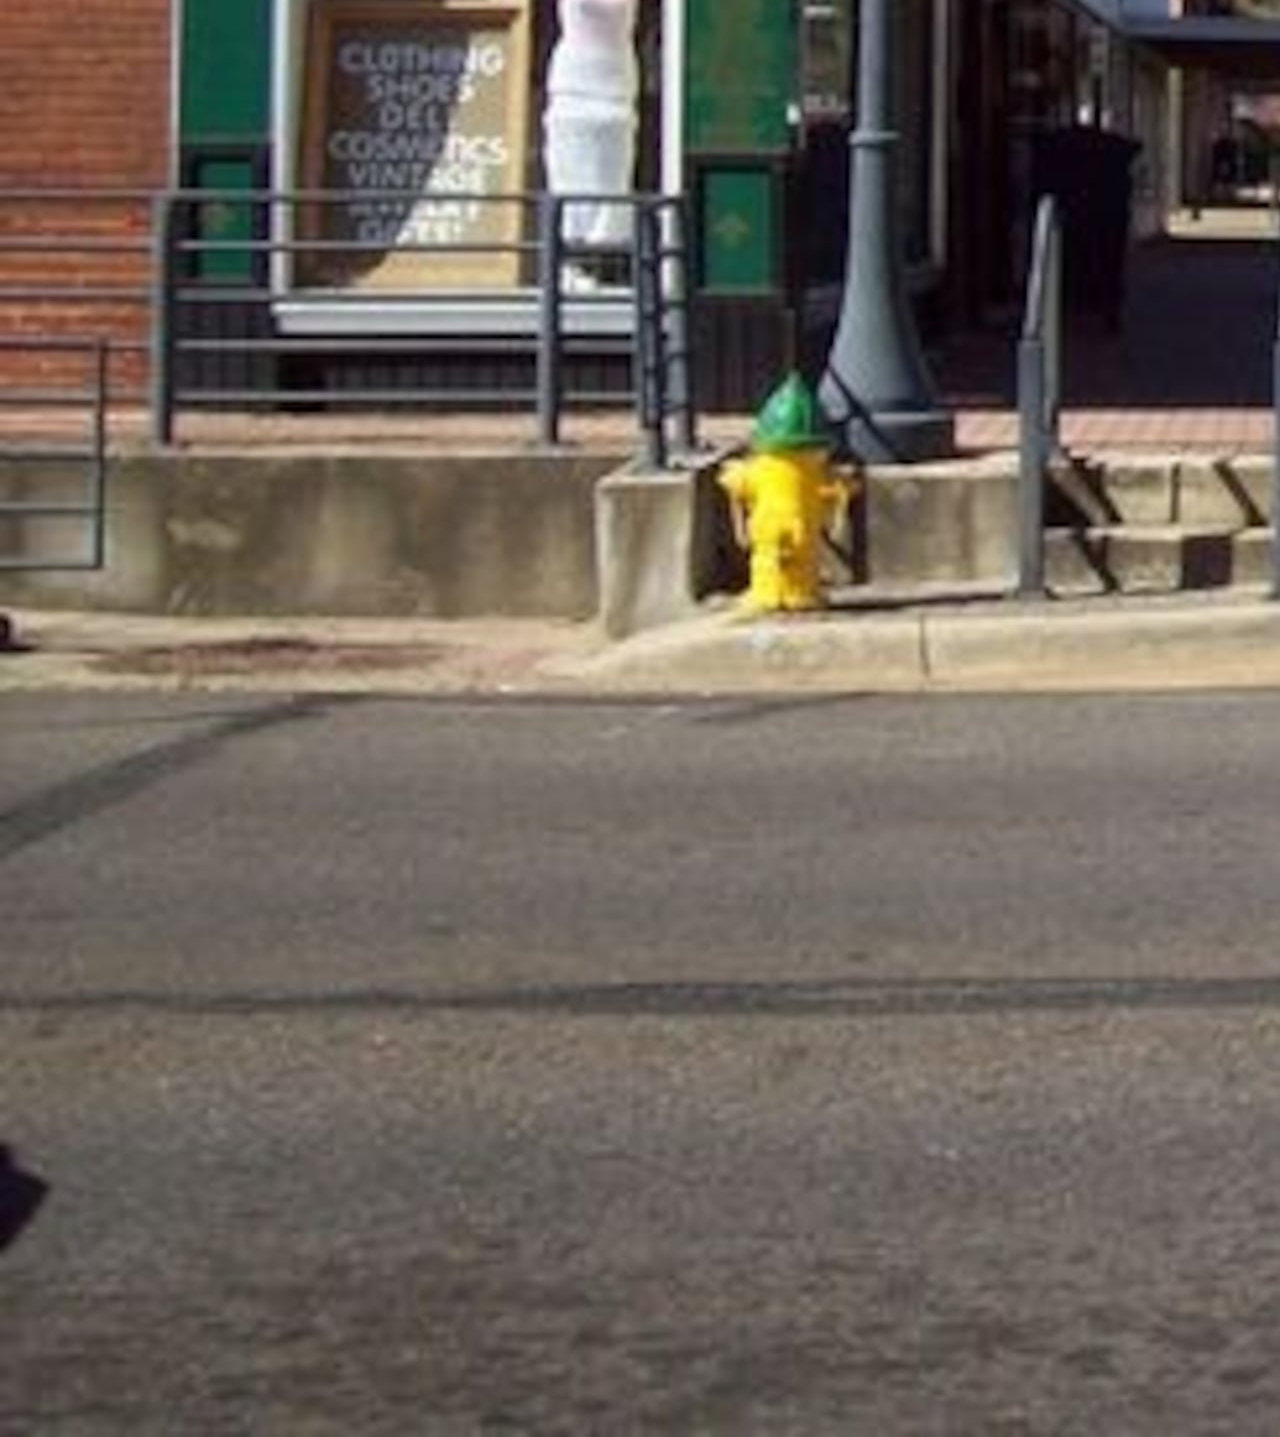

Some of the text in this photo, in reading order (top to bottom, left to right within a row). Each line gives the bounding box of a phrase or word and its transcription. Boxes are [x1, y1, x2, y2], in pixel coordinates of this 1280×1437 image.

[339, 43, 504, 75] CLOTHING
[367, 73, 475, 102] SHOES
[328, 130, 508, 163] COSMETICS
[349, 162, 486, 195] VINTAGE
